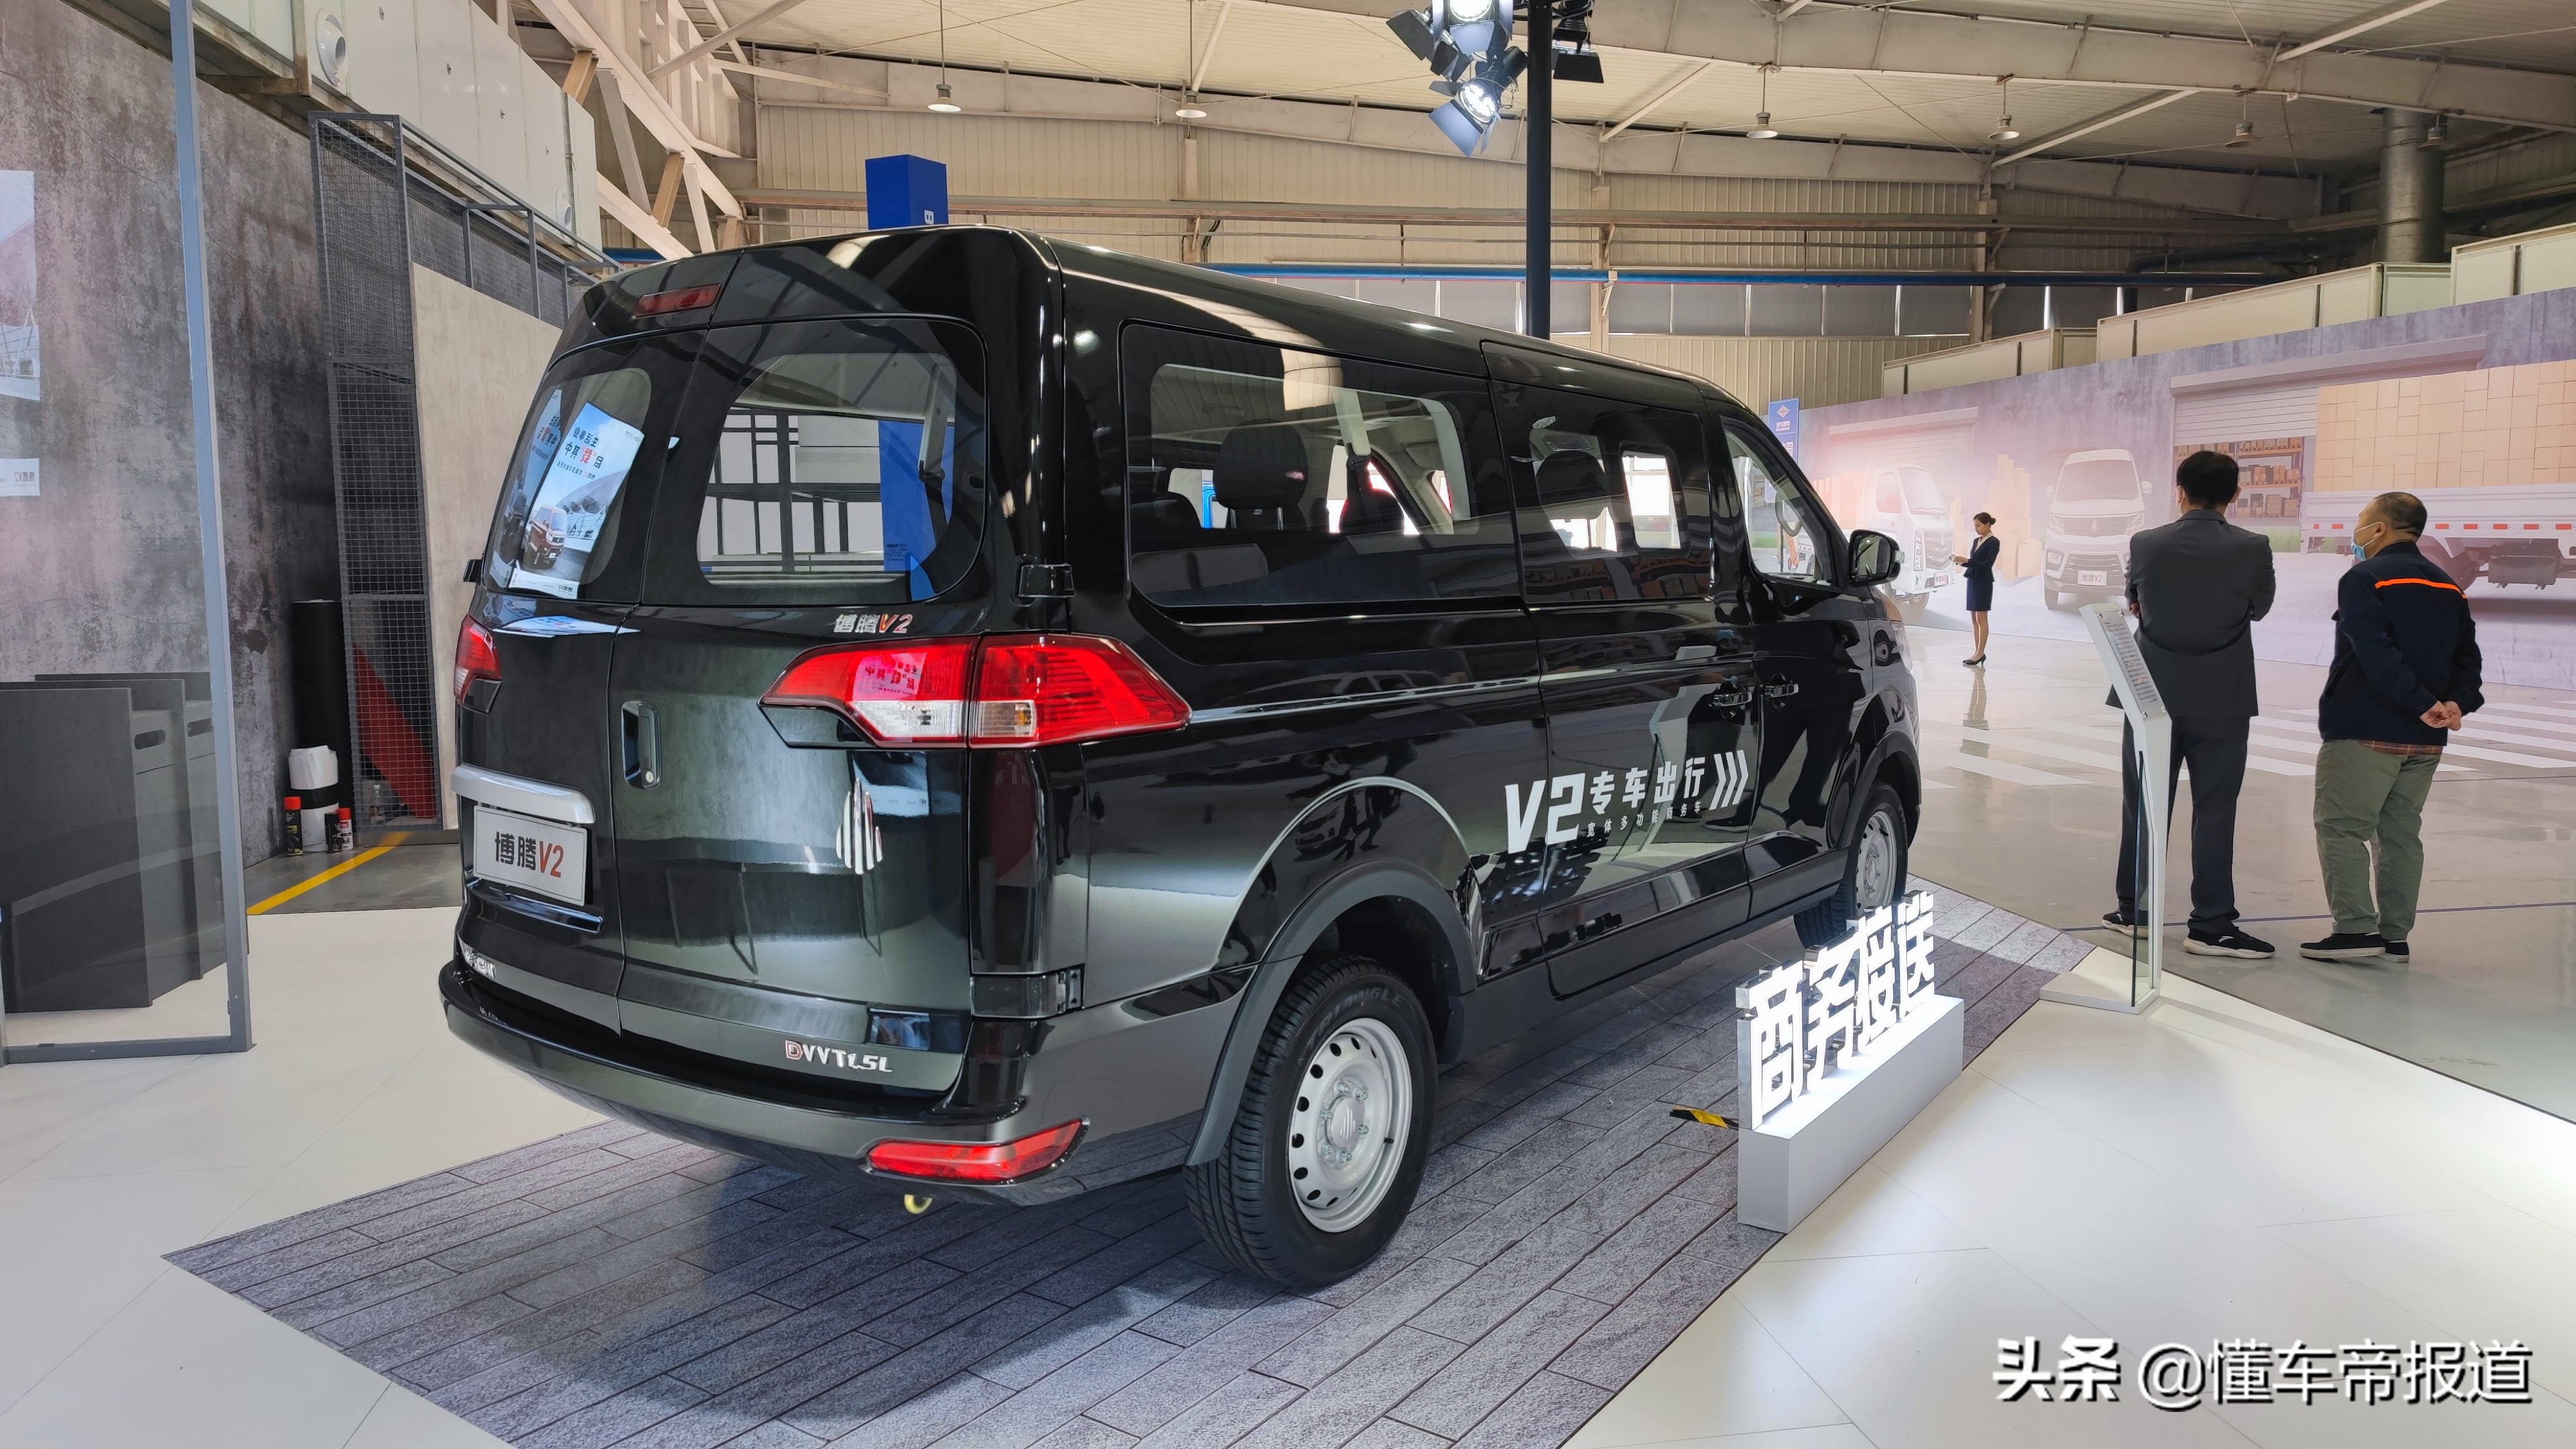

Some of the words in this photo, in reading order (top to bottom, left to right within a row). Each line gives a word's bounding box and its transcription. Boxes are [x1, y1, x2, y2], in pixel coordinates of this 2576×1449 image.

[834, 613, 913, 634] 博腾V2
[1587, 800, 1702, 838] 宽体多功能商务车
[495, 831, 564, 878] 博腾V2
[1745, 890, 1935, 1131] 商务接送
